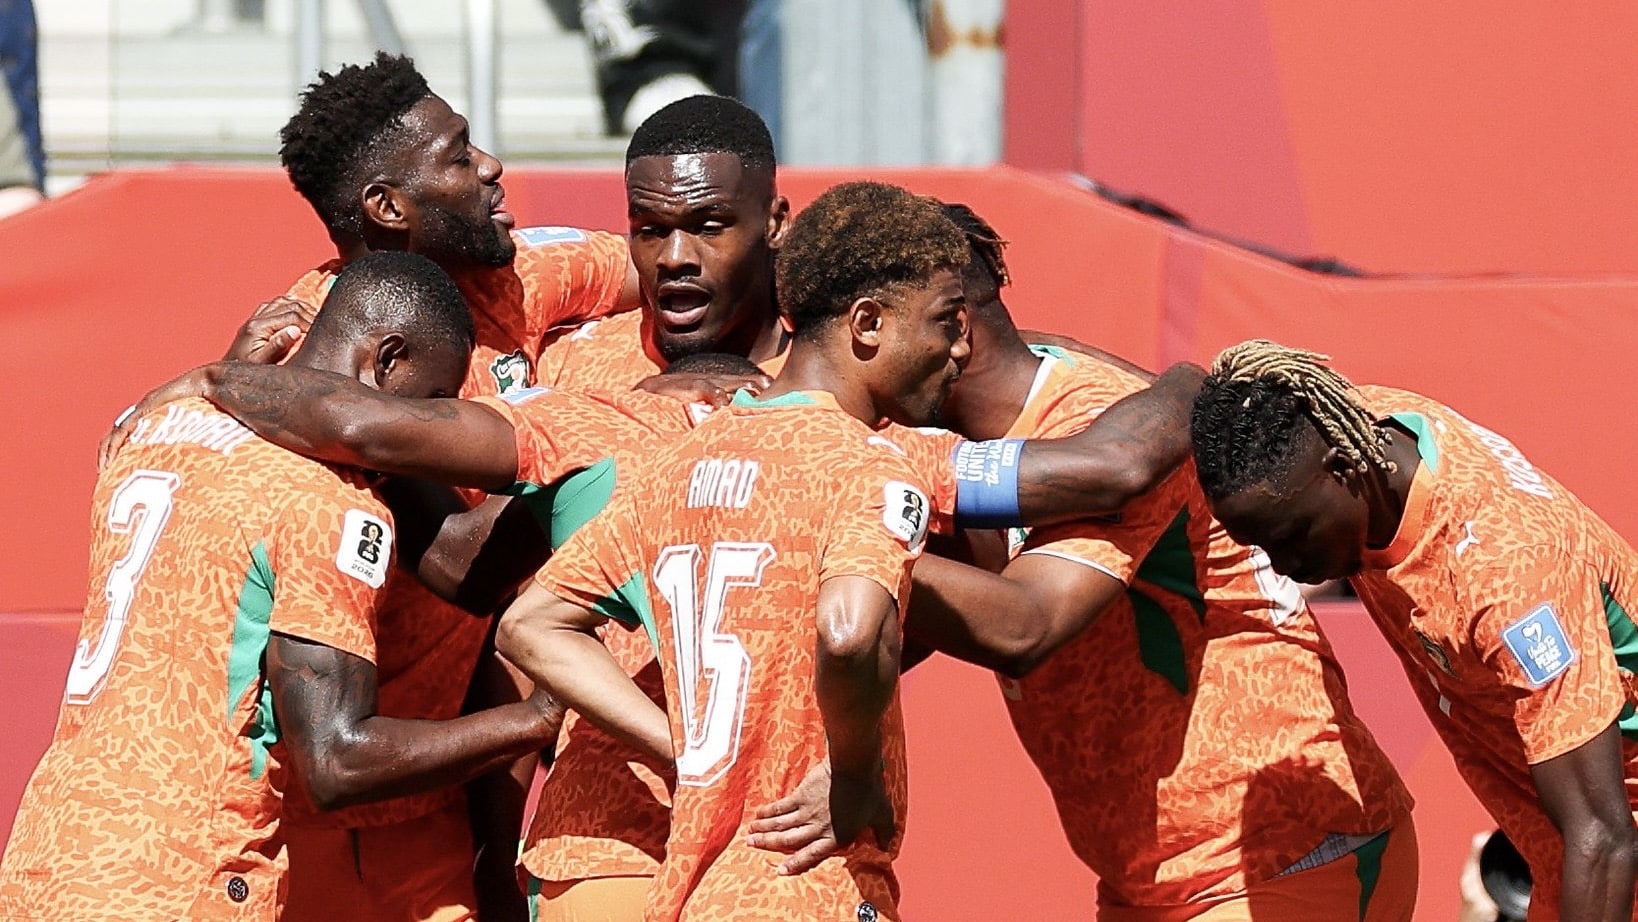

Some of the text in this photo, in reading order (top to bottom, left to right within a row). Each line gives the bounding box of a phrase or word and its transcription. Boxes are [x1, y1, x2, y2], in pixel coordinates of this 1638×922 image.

[687, 459, 759, 508] AMAD
[67, 469, 181, 705] 3
[351, 563, 375, 579] 2026
[653, 541, 777, 787] 15
